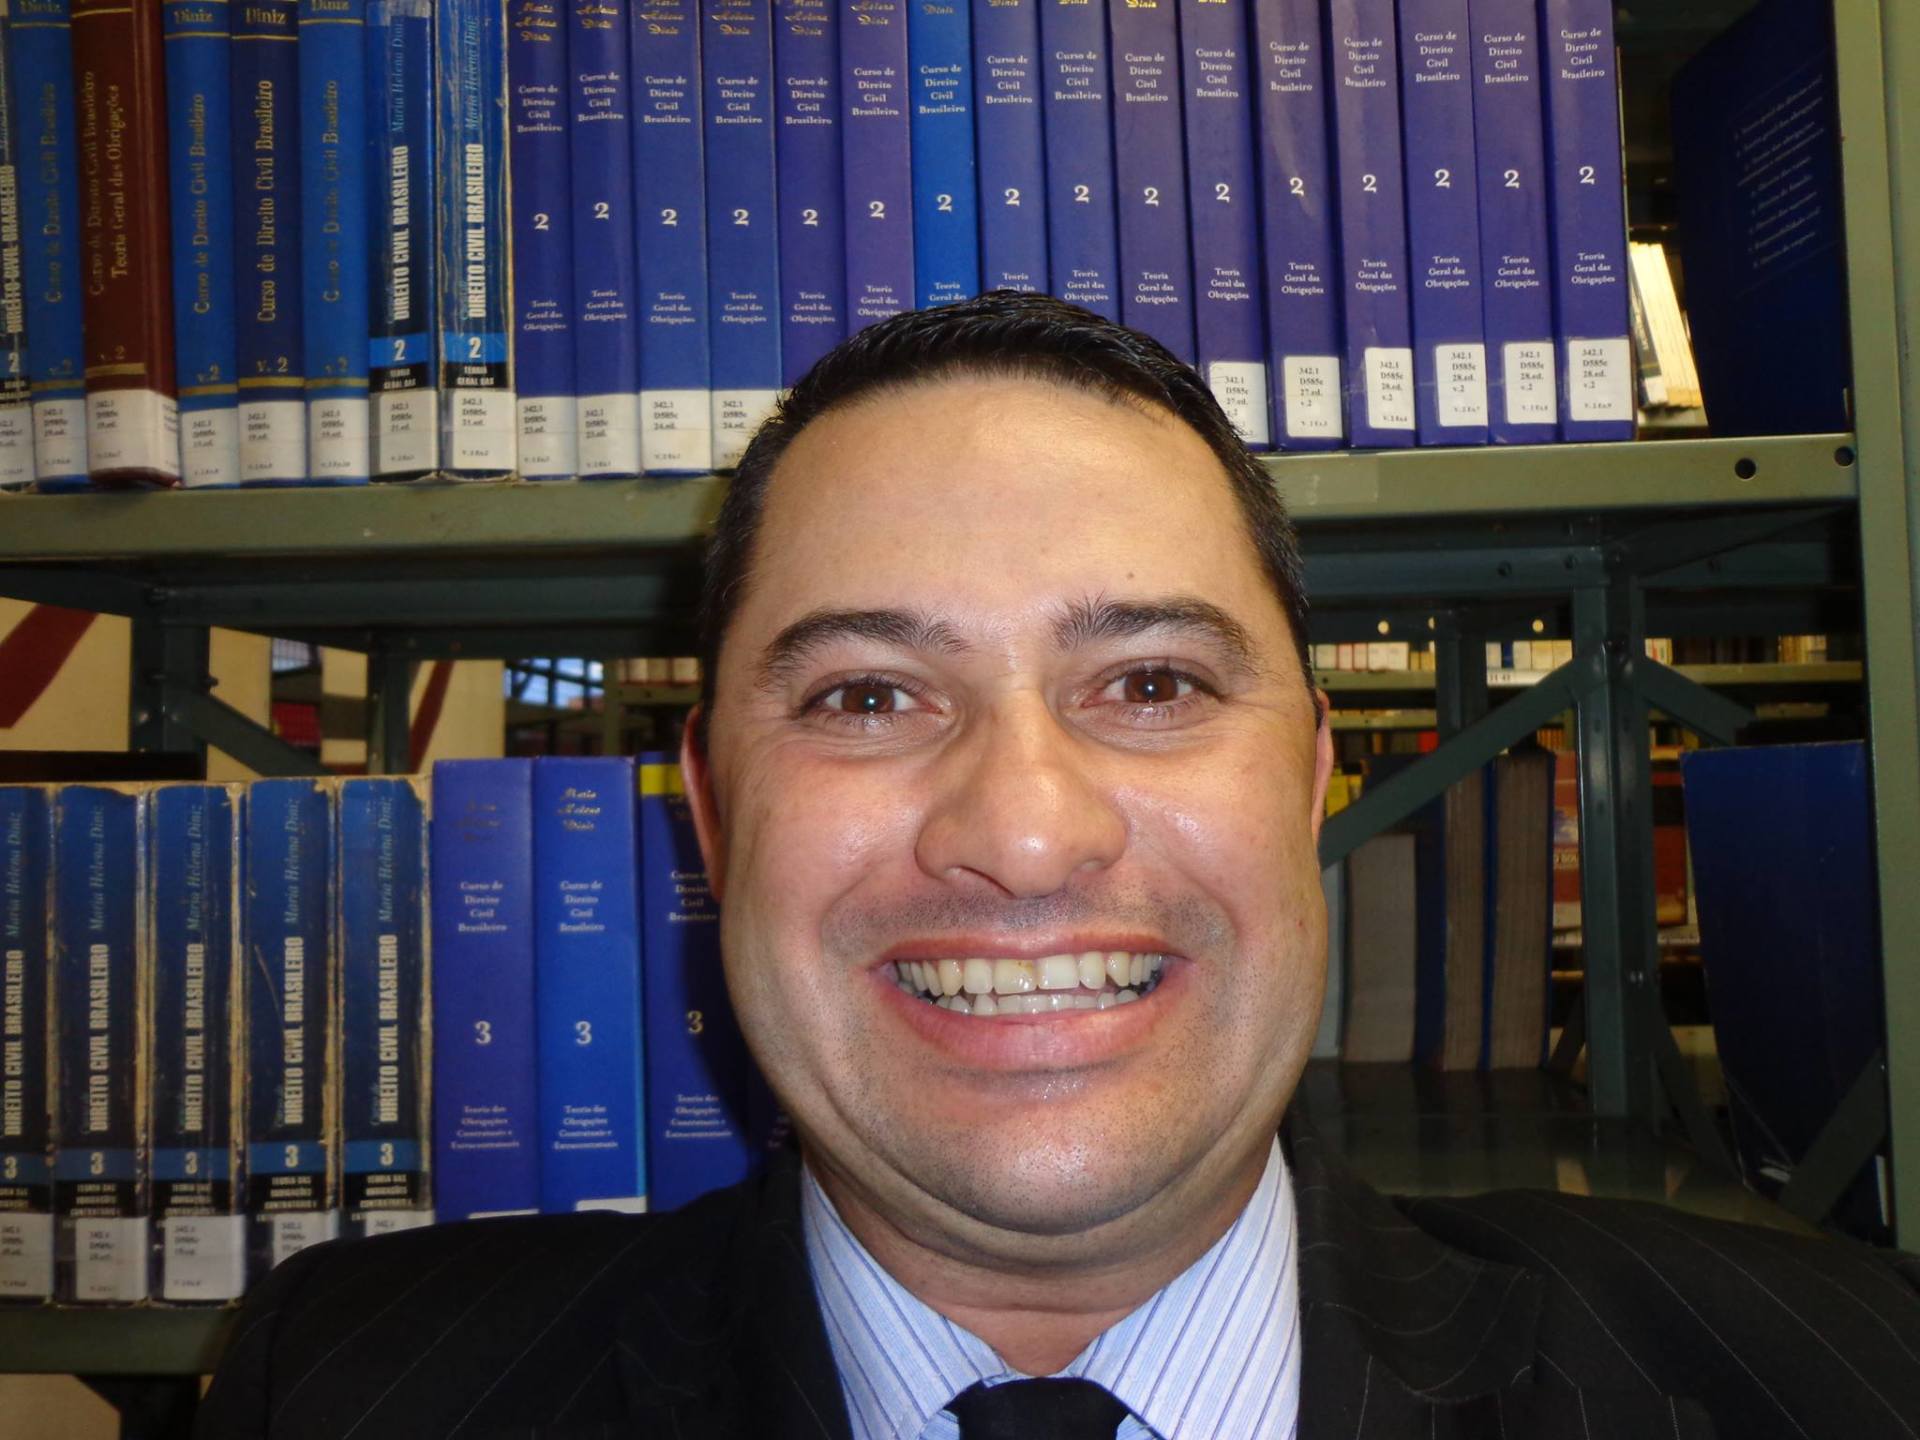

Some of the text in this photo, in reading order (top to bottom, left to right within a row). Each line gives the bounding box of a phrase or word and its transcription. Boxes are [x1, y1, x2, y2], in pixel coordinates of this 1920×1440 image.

[1415, 32, 1456, 43] Curso de
[1484, 33, 1526, 44] Curso de
[1561, 28, 1601, 39] Curso de
[1270, 42, 1309, 51] Curso de
[1344, 37, 1382, 48] Curso de
[1565, 42, 1598, 52] Direito
[1056, 51, 1097, 60] Curso de
[1196, 49, 1235, 58] Curso de
[1348, 52, 1379, 61] Direito
[1420, 46, 1453, 56] Direito
[1489, 47, 1522, 56] Direito
[987, 56, 1028, 64] Curso de
[1125, 53, 1165, 62] Curso de
[1274, 55, 1306, 64] Direito
[1426, 58, 1448, 68] Civil
[1571, 55, 1593, 66] Civil
[1060, 65, 1094, 73] Direito
[1200, 62, 1232, 71] Direito
[1354, 65, 1374, 75] Civil
[1495, 60, 1517, 70] Civil
[992, 69, 1025, 77] Direito
[1129, 67, 1162, 75] Direito
[1280, 69, 1301, 78] Civil
[1561, 68, 1605, 79] Brasileiro
[1066, 77, 1089, 86] Civil
[1207, 75, 1227, 84] Civil
[1415, 72, 1460, 82] Brasileiro
[1485, 73, 1529, 84] Brasileiro
[998, 82, 1020, 90] Civil
[1136, 79, 1157, 88] Civil
[1271, 81, 1313, 91] Brasileiro
[1345, 78, 1386, 88] Brasileiro
[1055, 91, 1102, 100] Brasileiro
[1125, 93, 1168, 102] Brasileiro
[1196, 89, 1239, 98] Brasileiro
[985, 95, 1032, 104] Brasileiro
[255, 80, 273, 150] Brasileiro
[256, 158, 274, 190] Civil
[1434, 168, 1450, 188] 2
[1504, 170, 1520, 188] 2
[1579, 166, 1595, 184] 2
[1290, 177, 1304, 196] 2
[1362, 174, 1377, 192] 2
[1005, 188, 1020, 206] 2
[1074, 185, 1090, 203] 2
[1144, 187, 1159, 206] 2
[1216, 183, 1230, 202] 2
[937, 194, 952, 212] 2
[594, 202, 609, 220] 2
[869, 201, 885, 218] 2
[256, 198, 274, 246] Direito
[534, 213, 549, 230] 2
[662, 209, 677, 226] 2
[734, 209, 749, 226] 2
[803, 209, 818, 226] 2
[392, 146, 410, 320] DIREITO CIVIL BRASILEIRO
[466, 144, 486, 318] DIREITO CIVIL BRASILEIRO
[1433, 256, 1460, 264] Teoria
[1502, 256, 1529, 264] Teoria
[1578, 252, 1605, 261] Teoria
[1428, 267, 1465, 277] Geral das
[1498, 267, 1535, 277] Geral das
[1574, 263, 1611, 273] Geral das
[258, 280, 274, 321] Curso
[394, 340, 406, 360] 2
[468, 337, 482, 358] 2
[8, 352, 19, 372] 2
[278, 357, 288, 372] 2
[687, 1010, 704, 1034] 3
[284, 937, 304, 1124] DIREITO CIVIL BRASILEIRO
[379, 935, 398, 1122] DIREITO CIVIL BRASILEIRO
[475, 1021, 492, 1044] 3
[575, 1021, 592, 1044] 3
[89, 944, 109, 1131] DIREITO CIVIL BRASILEIRO
[185, 944, 204, 1130] DIREITO CIVIL BRASILEIRO
[4, 950, 23, 1136] DIREITO CIVIL BRASILEIRO
[285, 1145, 298, 1167] 3
[380, 1143, 394, 1165] 3
[4, 1157, 17, 1178] 3
[90, 1152, 104, 1174] 3
[185, 1152, 198, 1174] 3
